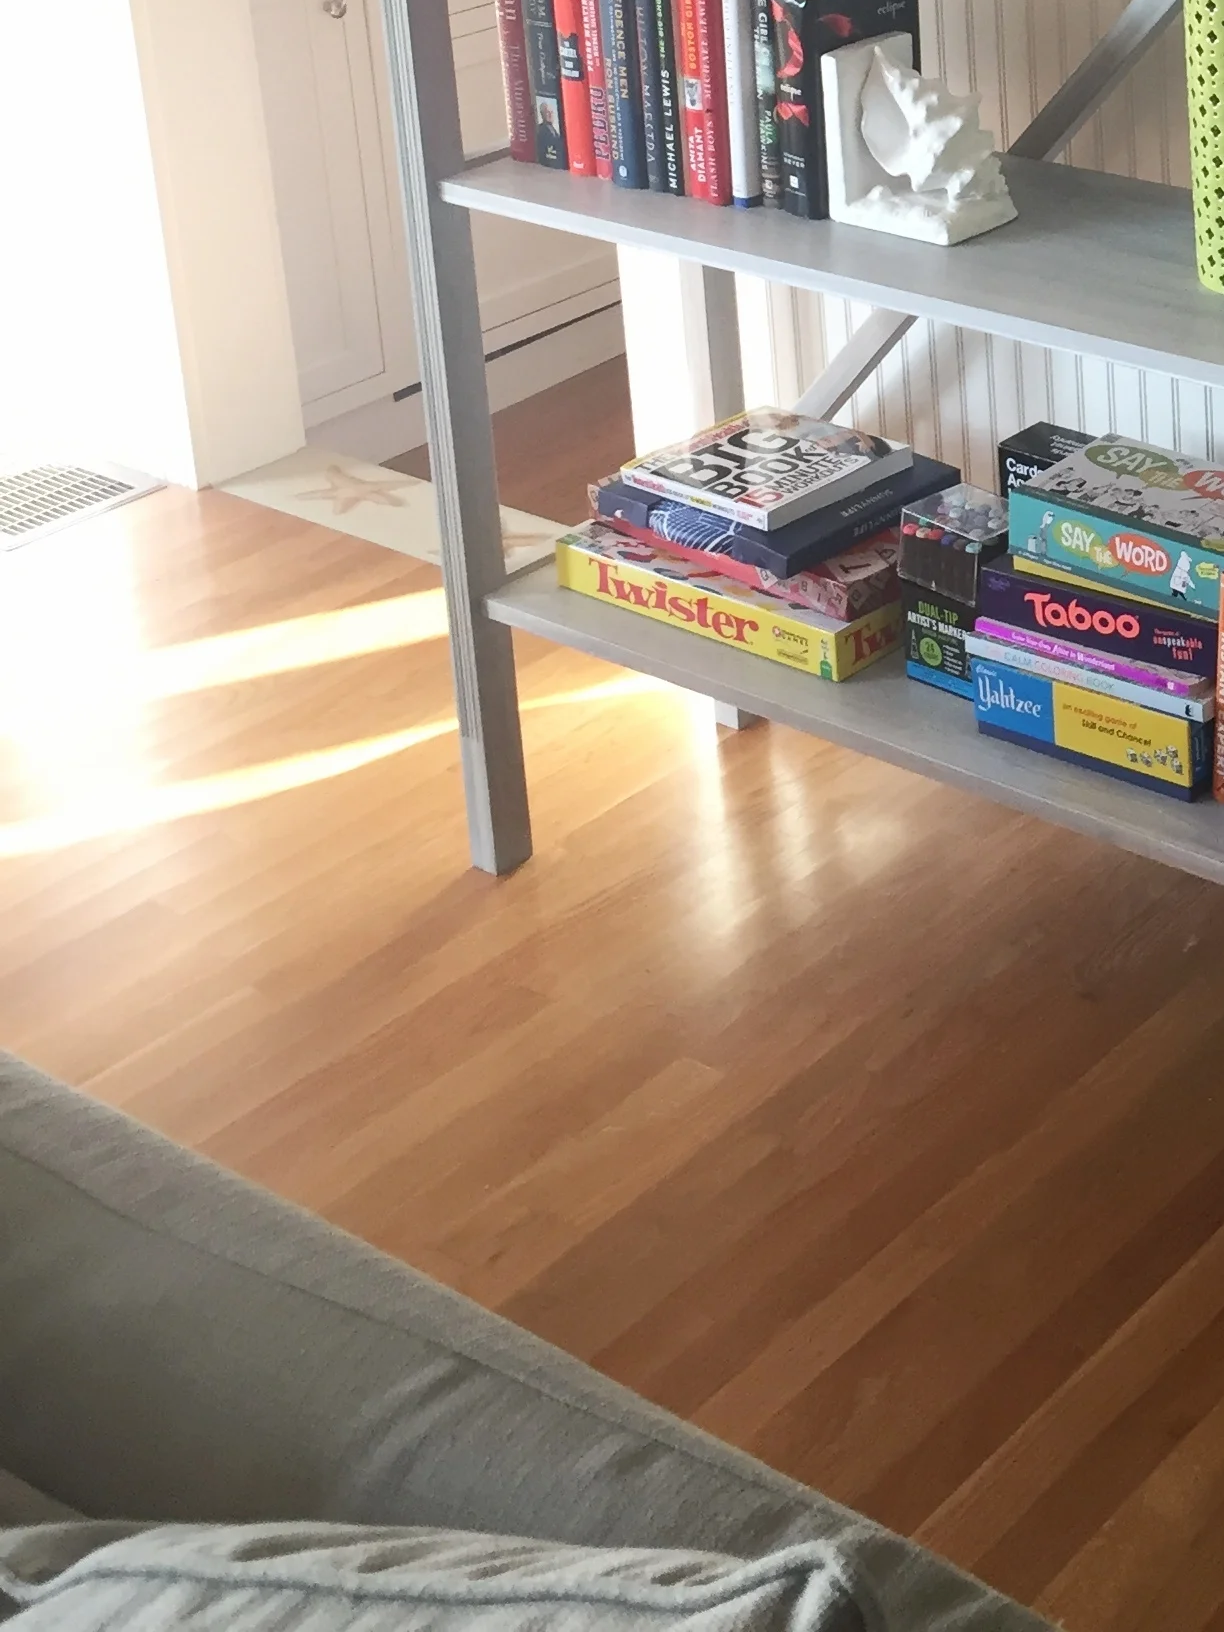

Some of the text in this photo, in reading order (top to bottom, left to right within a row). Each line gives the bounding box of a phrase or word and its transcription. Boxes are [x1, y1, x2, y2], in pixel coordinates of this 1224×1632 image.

[759, 12, 768, 41] GIRL
[876, 0, 907, 21] eclipse
[687, 28, 697, 70] BOSTON
[620, 65, 630, 100] MEN
[605, 57, 620, 160] RON SUSKIND
[661, 69, 678, 189] MICHAEL LEWIS
[764, 110, 774, 145] PAULA
[688, 135, 697, 172] ANITA
[695, 127, 706, 183] DIAMANT
[759, 118, 768, 170] HAWKINS
[649, 428, 802, 489] BIG
[703, 445, 826, 499] BOOK
[780, 454, 867, 495] WORKOUTS
[1097, 447, 1168, 471] SAY
[1148, 471, 1181, 487] THE
[733, 486, 784, 508] 15
[771, 453, 841, 490] MINUTE
[1060, 521, 1096, 553] SAY
[1095, 546, 1113, 565] THE
[1114, 536, 1168, 573] WORD
[587, 556, 760, 645] Twister
[907, 610, 937, 631] ARTIST'S
[917, 600, 959, 626] DUAL-TIP
[1023, 592, 1141, 639] Taboo
[1052, 644, 1069, 656] Alice
[1076, 652, 1117, 672] Wonderland
[977, 674, 1043, 719] Yahtzee
[1097, 723, 1153, 748] and Chance!
[1104, 715, 1127, 728] game
